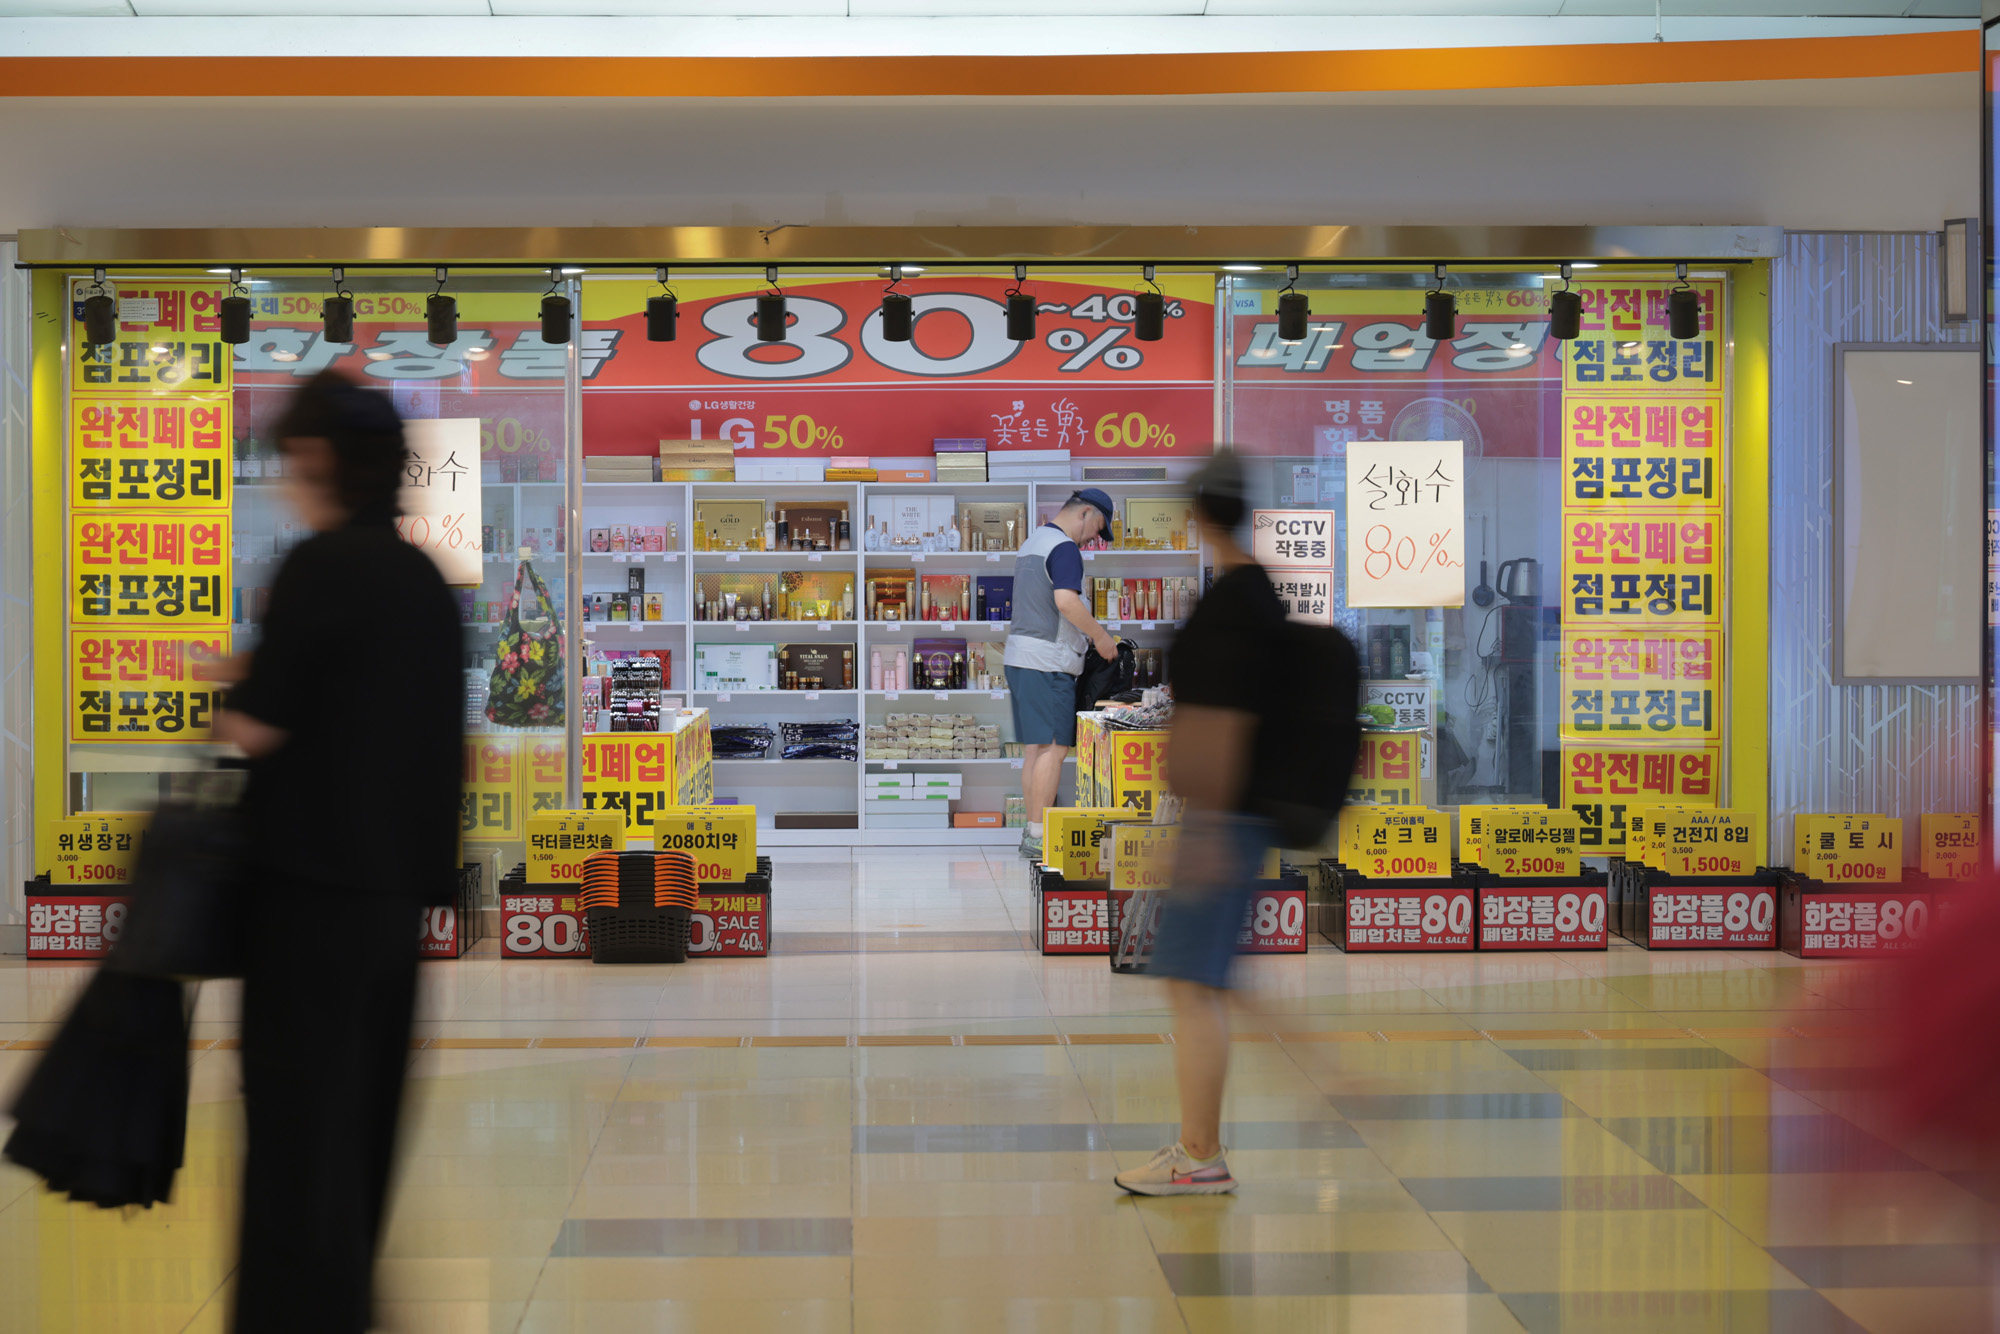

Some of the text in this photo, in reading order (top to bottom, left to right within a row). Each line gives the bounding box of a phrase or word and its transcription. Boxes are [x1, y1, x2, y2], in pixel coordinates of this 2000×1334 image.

[282, 297, 323, 315] 50%
[354, 297, 421, 315] G 50%
[1235, 299, 1255, 308] VISA
[1506, 290, 1550, 308] 60%
[84, 290, 222, 332] 폐업
[696, 292, 1143, 380] 80%
[1236, 321, 1562, 372] 폐업정
[80, 341, 222, 384] 점포정리
[1573, 340, 1714, 382] 점포정리
[704, 400, 755, 410] LG생활건강
[1324, 400, 1386, 424] 명품
[80, 406, 222, 449] 완전폐업
[763, 415, 844, 449] 50%
[1094, 412, 1176, 448] 60%
[1572, 405, 1713, 448] 완전폐업
[79, 458, 222, 501] 점포정리
[407, 450, 469, 492] 화수
[1572, 457, 1713, 499] 점포정리
[1357, 459, 1454, 511] 설화수
[1275, 520, 1326, 535] CCTV
[80, 522, 221, 565] 완전폐업
[1275, 540, 1326, 558] 작동중
[1572, 522, 1713, 564] 완전폐업
[79, 574, 221, 617] 점포정리
[1271, 582, 1326, 597] 난적발시
[1571, 573, 1712, 616] 점포정리
[1297, 599, 1325, 614] 배상
[79, 639, 221, 681] 완전폐업
[1571, 638, 1712, 680] 완전폐업
[1384, 692, 1425, 705] CCTV
[79, 691, 221, 733] 점포정리
[1394, 708, 1426, 722] 동중
[1571, 690, 1712, 732] 점포정리
[1570, 752, 1712, 795] 완전폐업
[83, 823, 109, 832] 고급
[558, 822, 585, 831] 고급
[686, 822, 713, 831] 애경
[1384, 816, 1425, 826] 푸드어홀릭
[1521, 816, 1548, 825] 고급
[1691, 816, 1709, 824] AAA
[1718, 816, 1731, 824] AA
[1843, 821, 1870, 830] 고급
[58, 833, 133, 851] 위생장갑
[531, 833, 613, 850] 닥터클린칫솔
[662, 833, 738, 850] 2080치약
[1144, 829, 1167, 839] 고급
[1372, 827, 1438, 844] 선크림
[1466, 837, 1482, 845] 2,00
[1494, 827, 1575, 844] 알로에수딩젤
[1672, 826, 1749, 844] 건전지 8입
[1819, 832, 1893, 850] 쿨토시
[1935, 832, 1979, 848] 양모신
[532, 853, 554, 861] 1,500
[1069, 851, 1091, 859] 2,000
[1366, 848, 1387, 856] 6,000
[1672, 846, 1693, 854] 3,500
[67, 864, 128, 882] 1,500원
[550, 863, 583, 879] 500
[697, 864, 733, 880] 00원
[1373, 857, 1438, 875] 3,000원
[1504, 857, 1565, 875] 2,500원
[1681, 857, 1741, 874] 1,500원
[1826, 863, 1887, 880] 1,000원
[1945, 861, 1979, 879] 1,00
[505, 897, 554, 912] 화장품
[1482, 893, 1605, 933] 화장품 80%
[1652, 892, 1775, 932] 화장품 80%
[29, 902, 128, 942] 화장품 8
[718, 915, 761, 930] SALE
[1253, 896, 1304, 937] 80%
[1349, 894, 1472, 935] 화장품 80%
[1804, 901, 1878, 932] 화장품
[505, 913, 586, 953] 80%
[1047, 930, 1119, 946] 폐업처분
[1258, 938, 1300, 946] ALL SALE
[1349, 927, 1468, 944] 폐업처분 ALL SALE
[1482, 926, 1555, 942] 폐업처분
[1651, 925, 1770, 942] 폐업처분 ALL SALE
[1804, 934, 1878, 949] 폐업처분
[29, 935, 103, 951] 폐업처분
[427, 943, 451, 951] SALE
